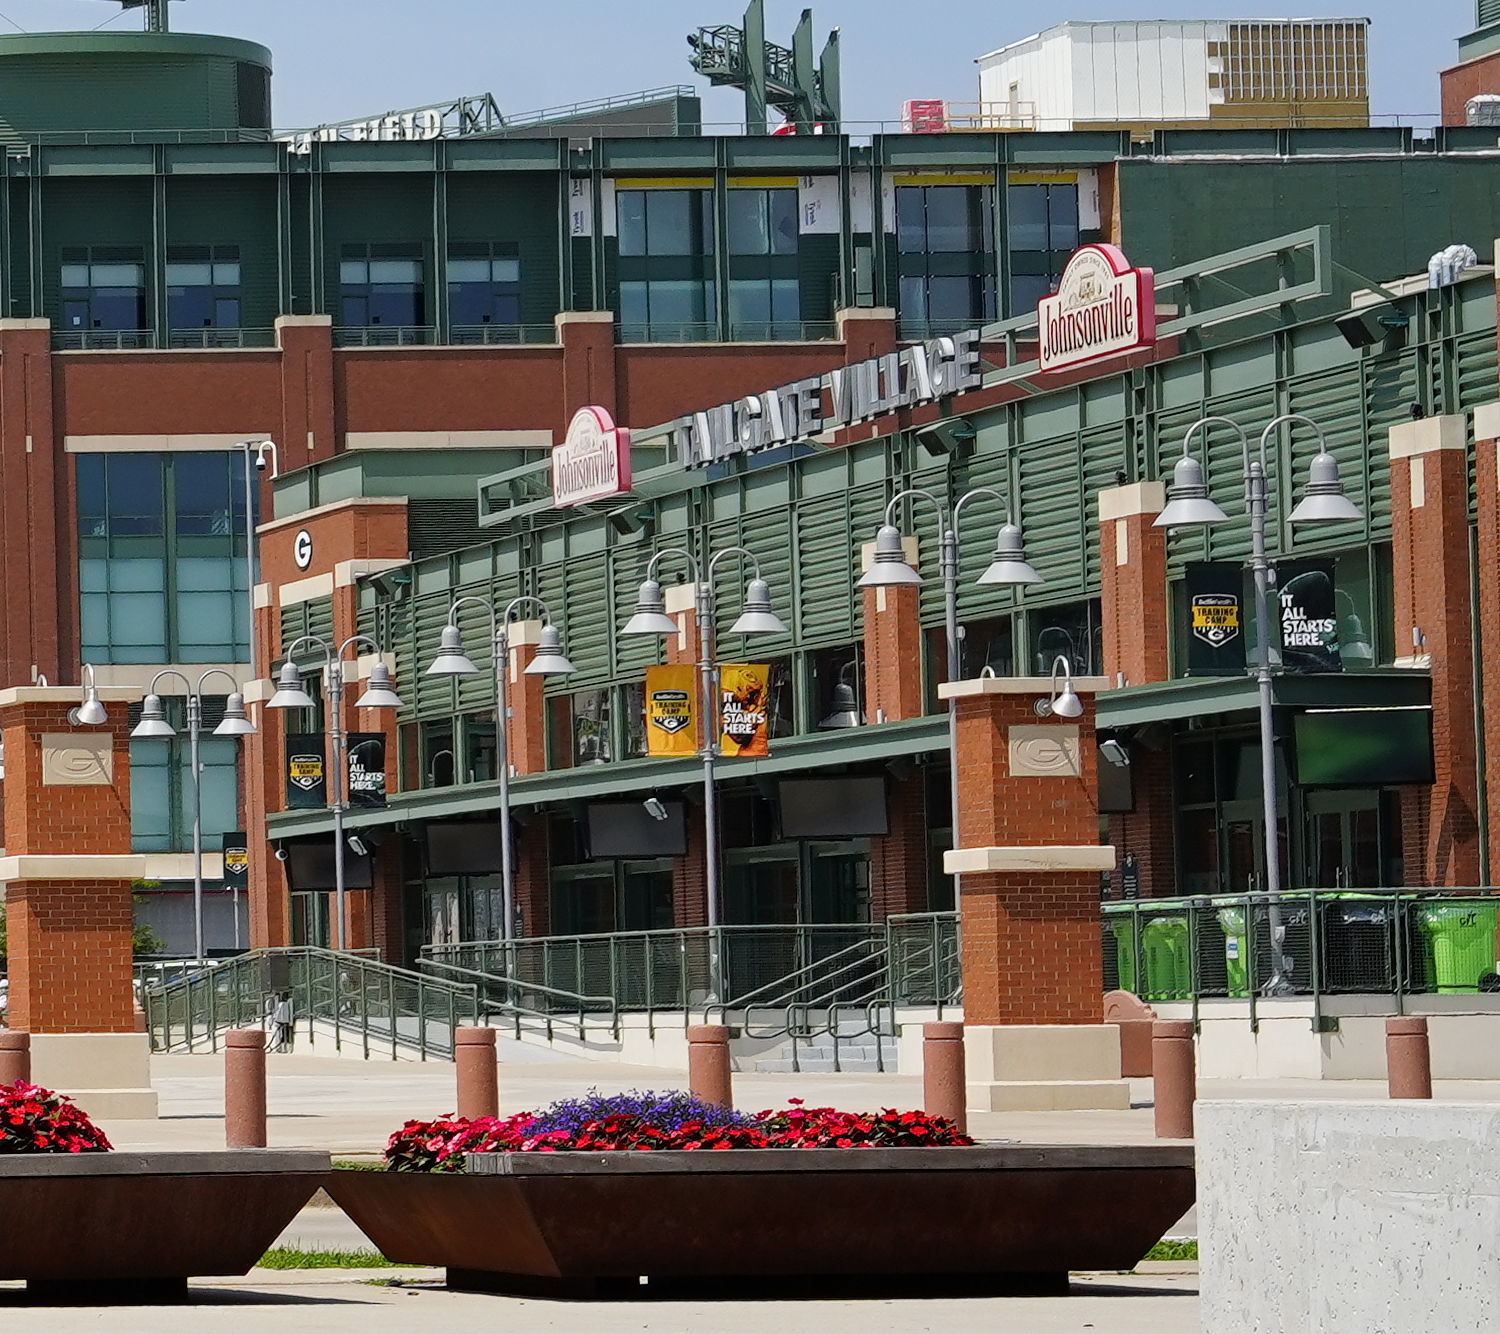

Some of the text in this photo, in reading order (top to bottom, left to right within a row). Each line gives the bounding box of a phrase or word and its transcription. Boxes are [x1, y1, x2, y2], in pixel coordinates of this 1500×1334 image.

[1043, 283, 1134, 362] Johnsonville
[673, 328, 982, 468] TAILGATE VILLAGE
[556, 439, 616, 499] Johnsonville
[293, 530, 312, 568] G
[1281, 594, 1294, 607] IT
[1197, 608, 1234, 616] TRAINING
[1282, 607, 1307, 620] ALL
[1205, 616, 1227, 624] CAMP
[1283, 619, 1333, 633] STARTS
[1284, 633, 1324, 647] HERE.
[723, 692, 734, 702] IT
[723, 703, 743, 713] ALL
[723, 713, 765, 723] STARTS
[723, 723, 756, 734] HERE.
[349, 754, 359, 764] IT
[349, 764, 365, 772] ALL
[350, 772, 384, 781] STARTS
